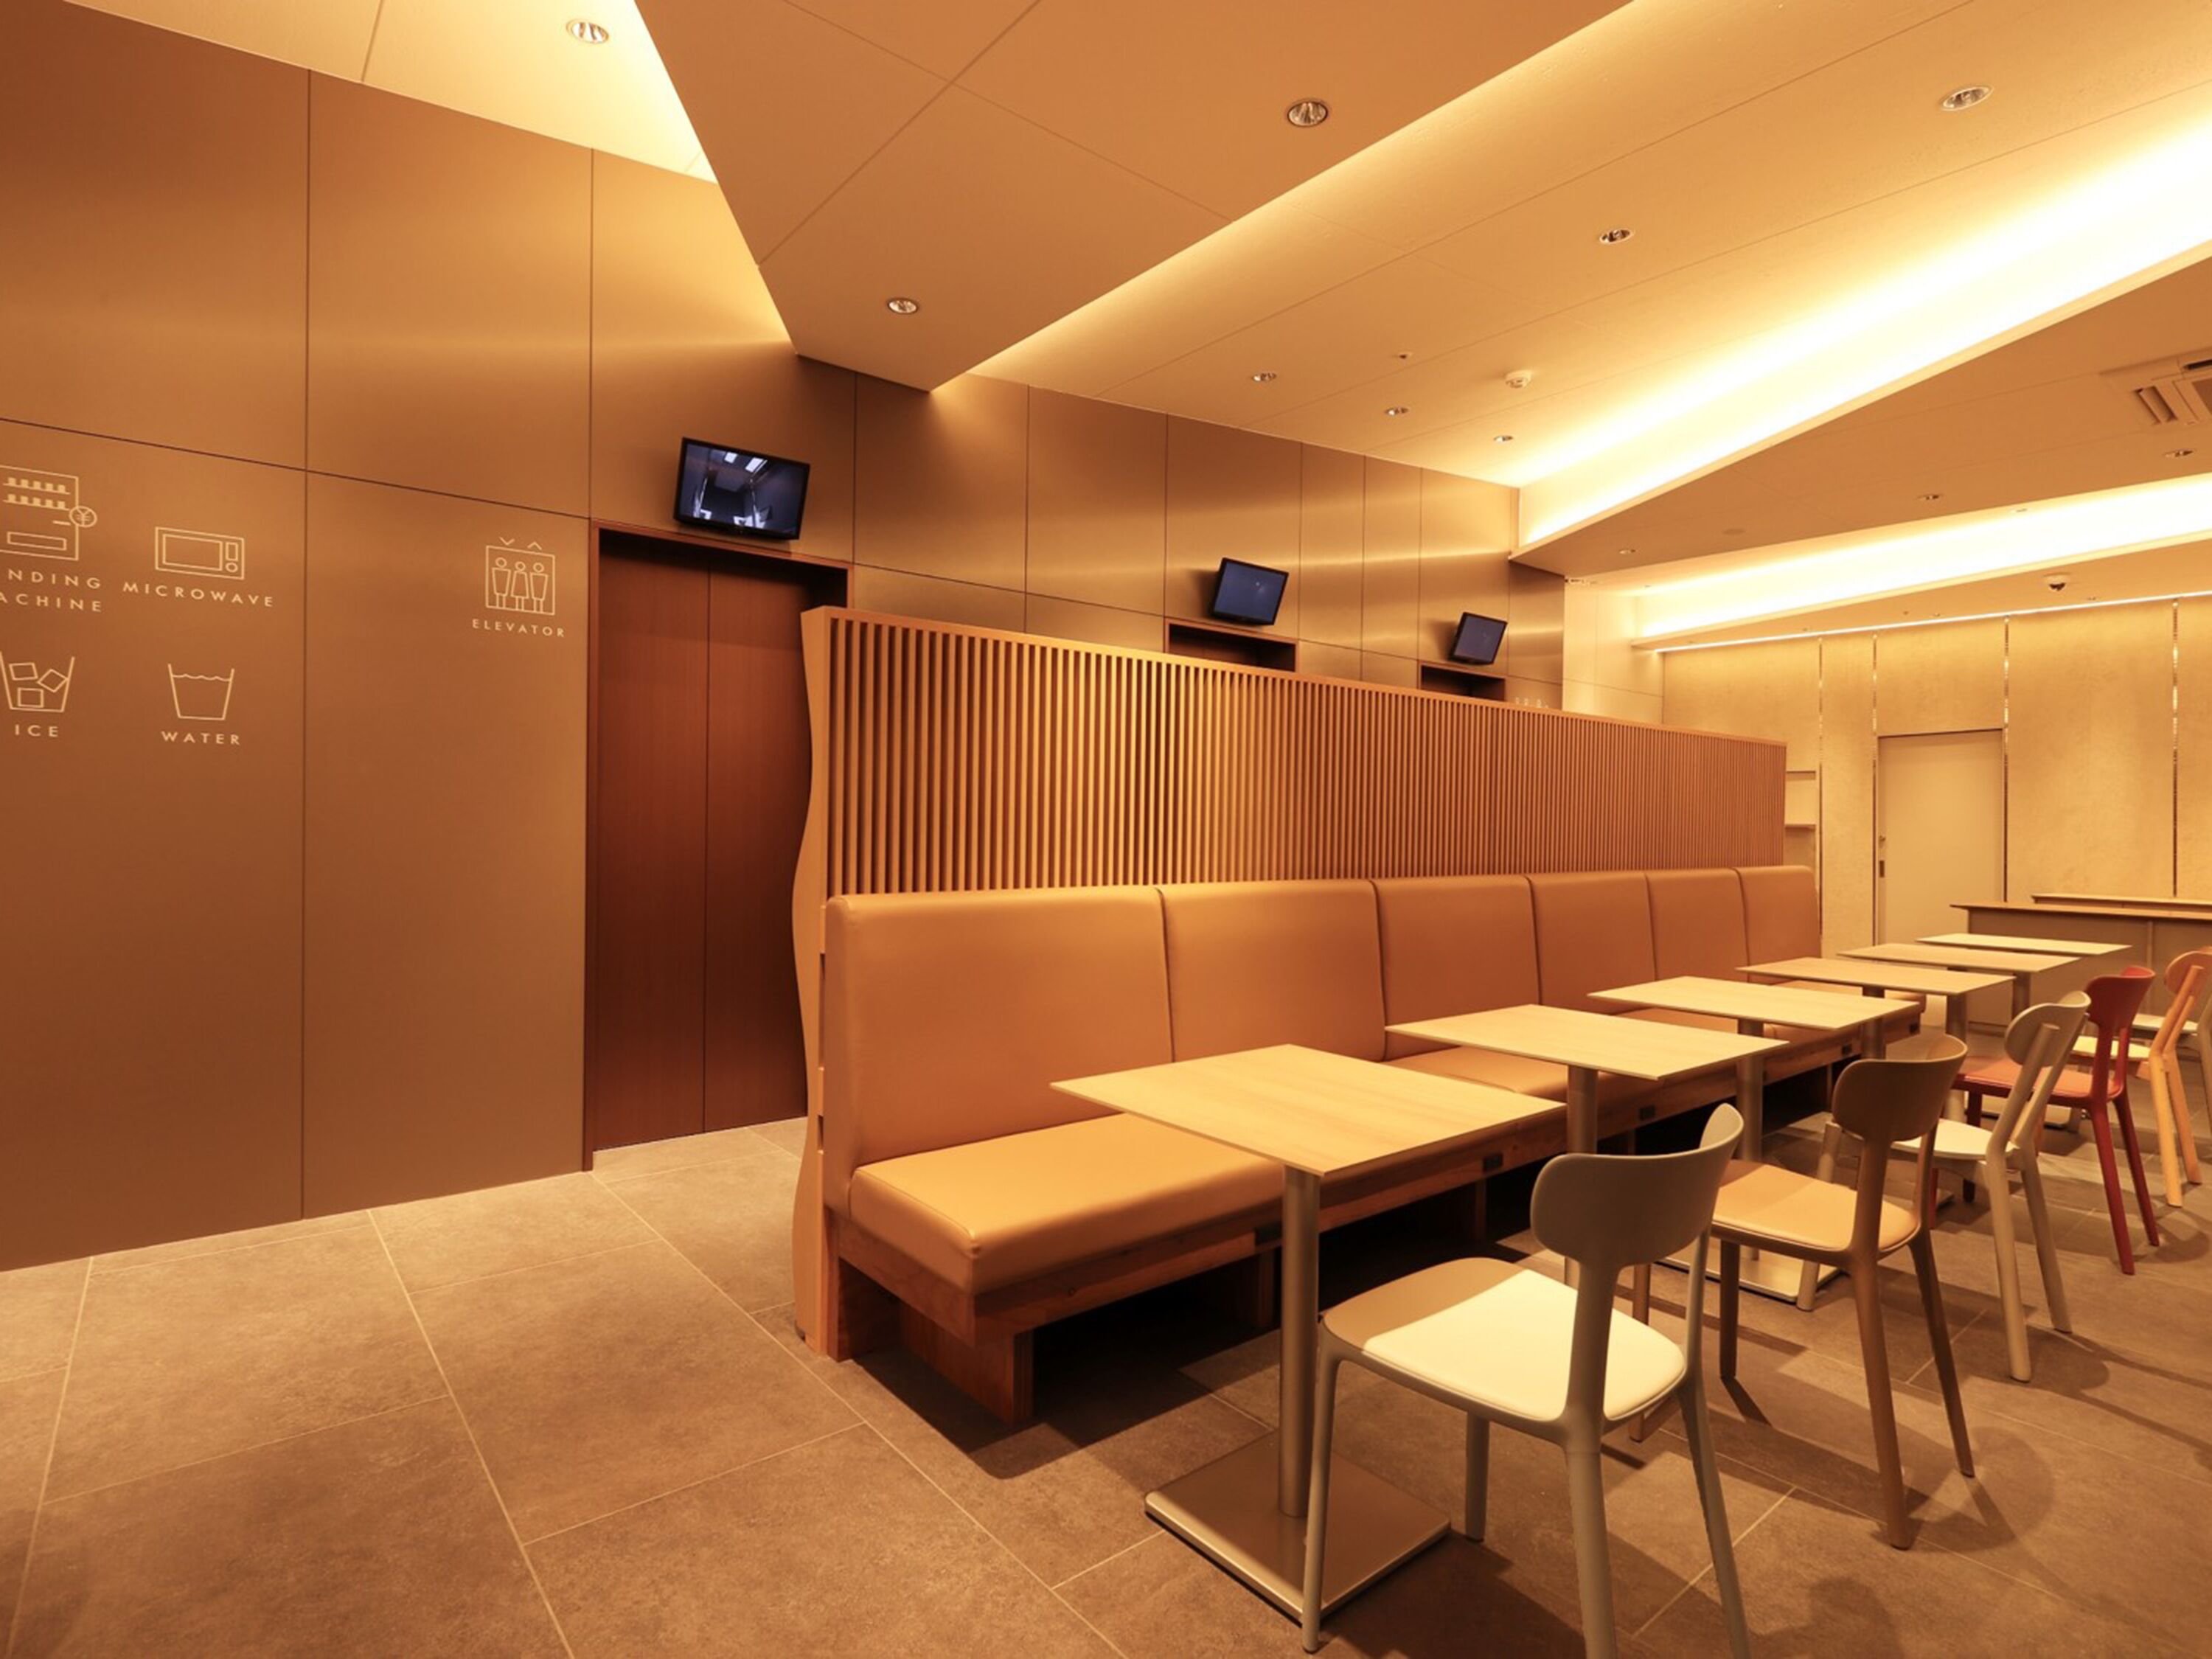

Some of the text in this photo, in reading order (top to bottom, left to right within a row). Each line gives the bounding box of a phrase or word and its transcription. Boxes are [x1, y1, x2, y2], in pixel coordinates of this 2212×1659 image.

[122, 581, 274, 608] MICROWAVE
[472, 618, 565, 638] ELEVATOR
[14, 723, 59, 738] ICE
[160, 730, 241, 745] WATER
